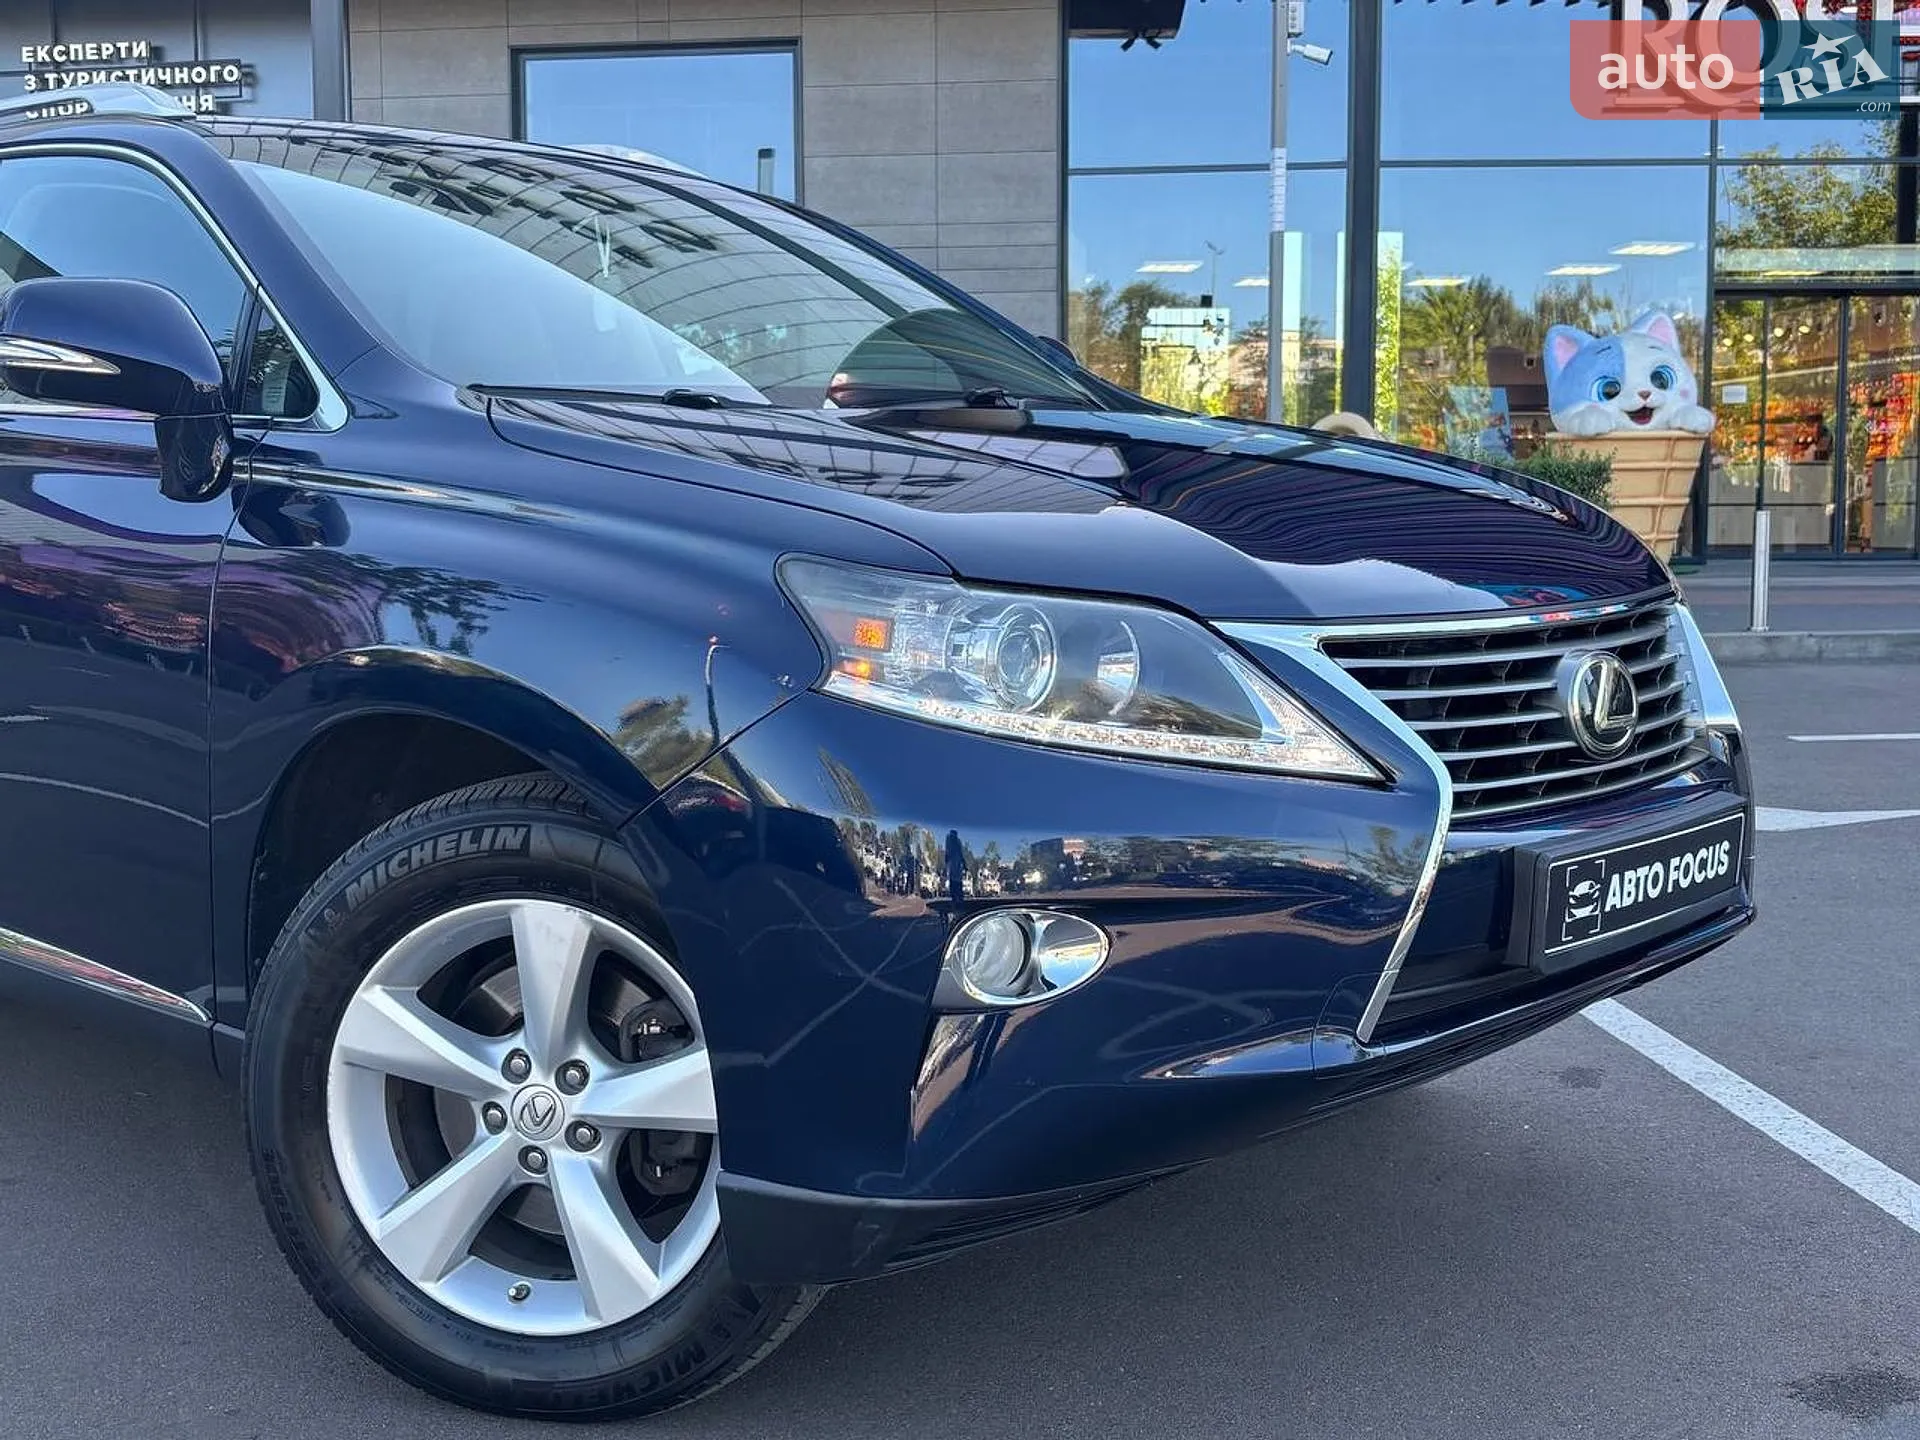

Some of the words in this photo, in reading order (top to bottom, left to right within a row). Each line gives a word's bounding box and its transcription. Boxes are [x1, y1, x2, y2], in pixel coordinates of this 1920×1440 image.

[21, 40, 149, 63] ЕКСПЕРТИ
[23, 74, 37, 91] З
[45, 64, 239, 88] ТУРИСТИЧНОГО
[344, 826, 530, 913] MICHELIN
[1667, 840, 1730, 893] FOCUS
